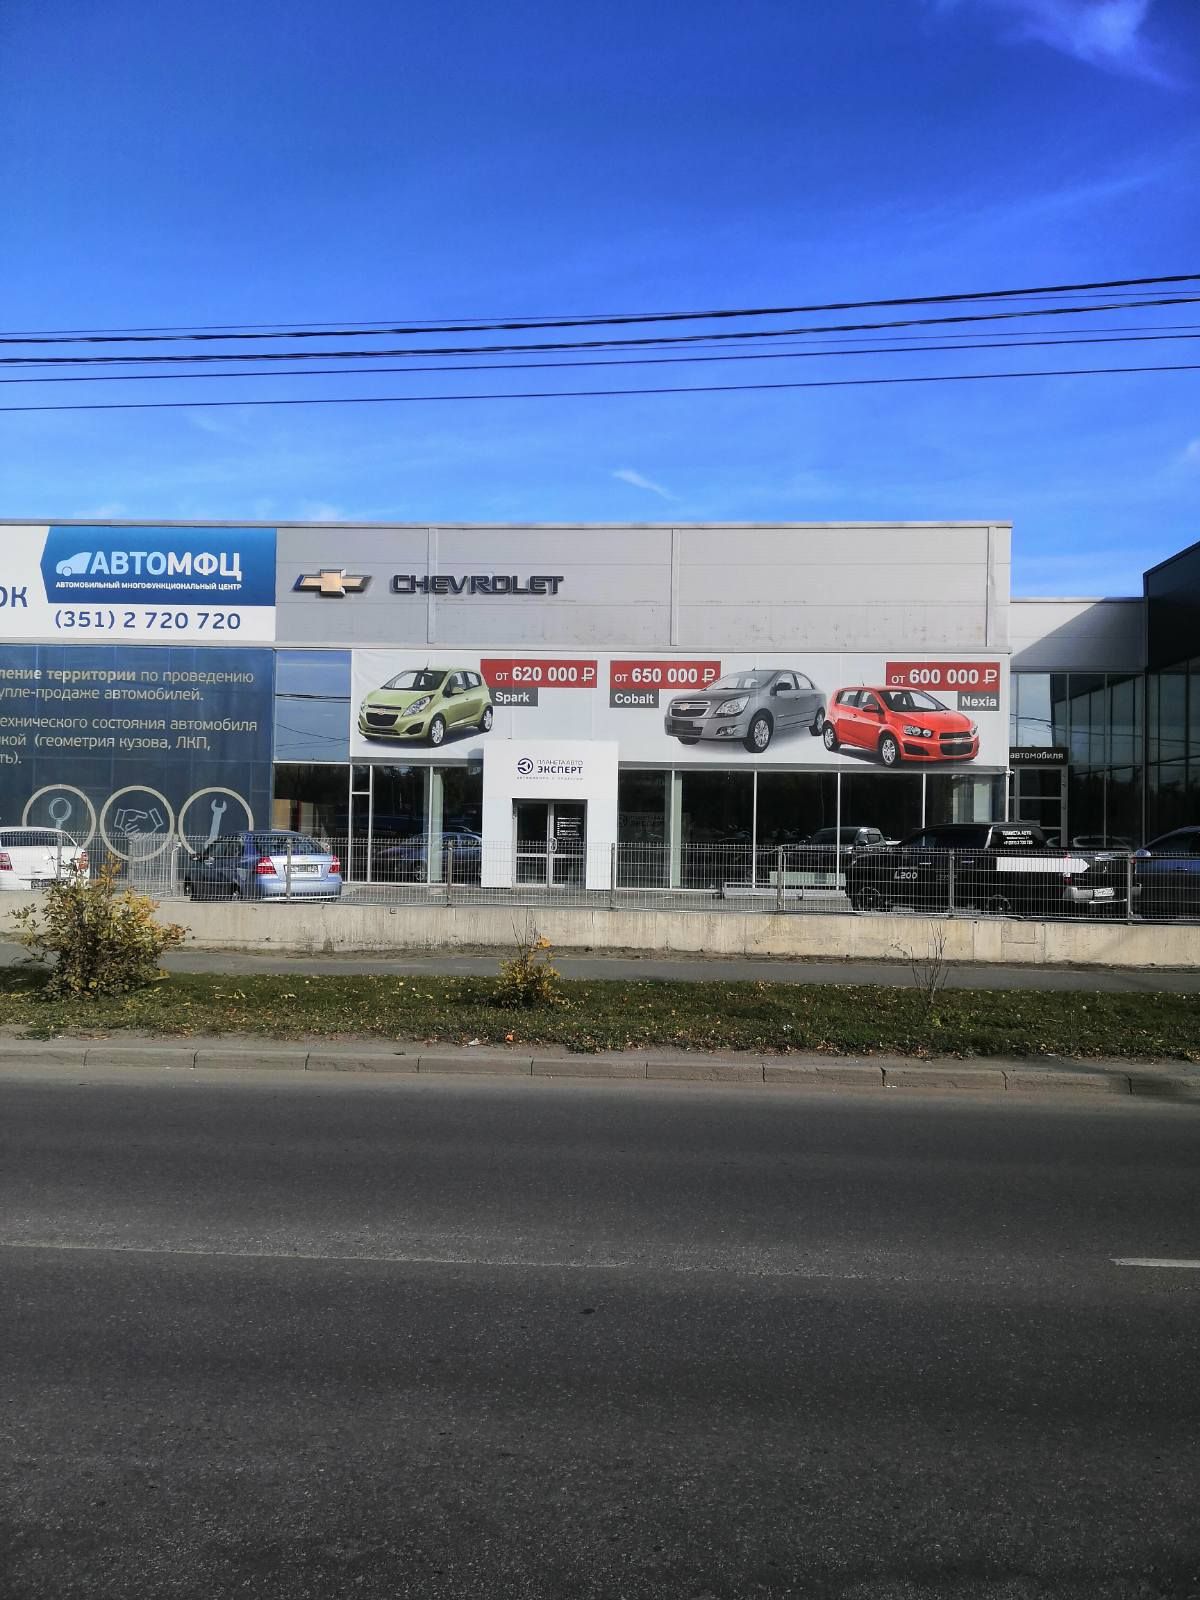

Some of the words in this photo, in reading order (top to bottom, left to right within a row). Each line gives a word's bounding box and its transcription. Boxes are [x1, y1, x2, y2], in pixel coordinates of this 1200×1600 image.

[90, 551, 242, 581] АВТОМФЦ
[55, 581, 120, 589] АВТОМОБИЛЬНЫЙ
[121, 582, 217, 590] МНОГОФУНКЦИОНАЛЬНЫЙ
[392, 574, 564, 594] CHEVROLET
[55, 609, 115, 629] (351)
[123, 612, 136, 628] 2
[145, 612, 188, 629] 720
[197, 613, 241, 630] 720
[46, 670, 136, 683] территории
[141, 671, 158, 682] по
[163, 671, 254, 684] проведению
[512, 666, 542, 681] 620
[547, 667, 578, 682] 000
[631, 668, 662, 683] 650
[667, 668, 698, 683] 000
[909, 669, 941, 684] 600
[946, 669, 979, 684] 000
[104, 688, 204, 701] автомобилей.
[495, 691, 530, 705] Spark
[614, 693, 655, 704] Cobalt
[961, 695, 997, 707] Nexia
[92, 718, 166, 730] состояния
[170, 718, 257, 731] автомобиля
[34, 733, 115, 749] (геометрия
[119, 738, 172, 750] кузова,
[175, 737, 211, 751] ЛКП,
[537, 766, 583, 774] ЭКСПЕРТ
